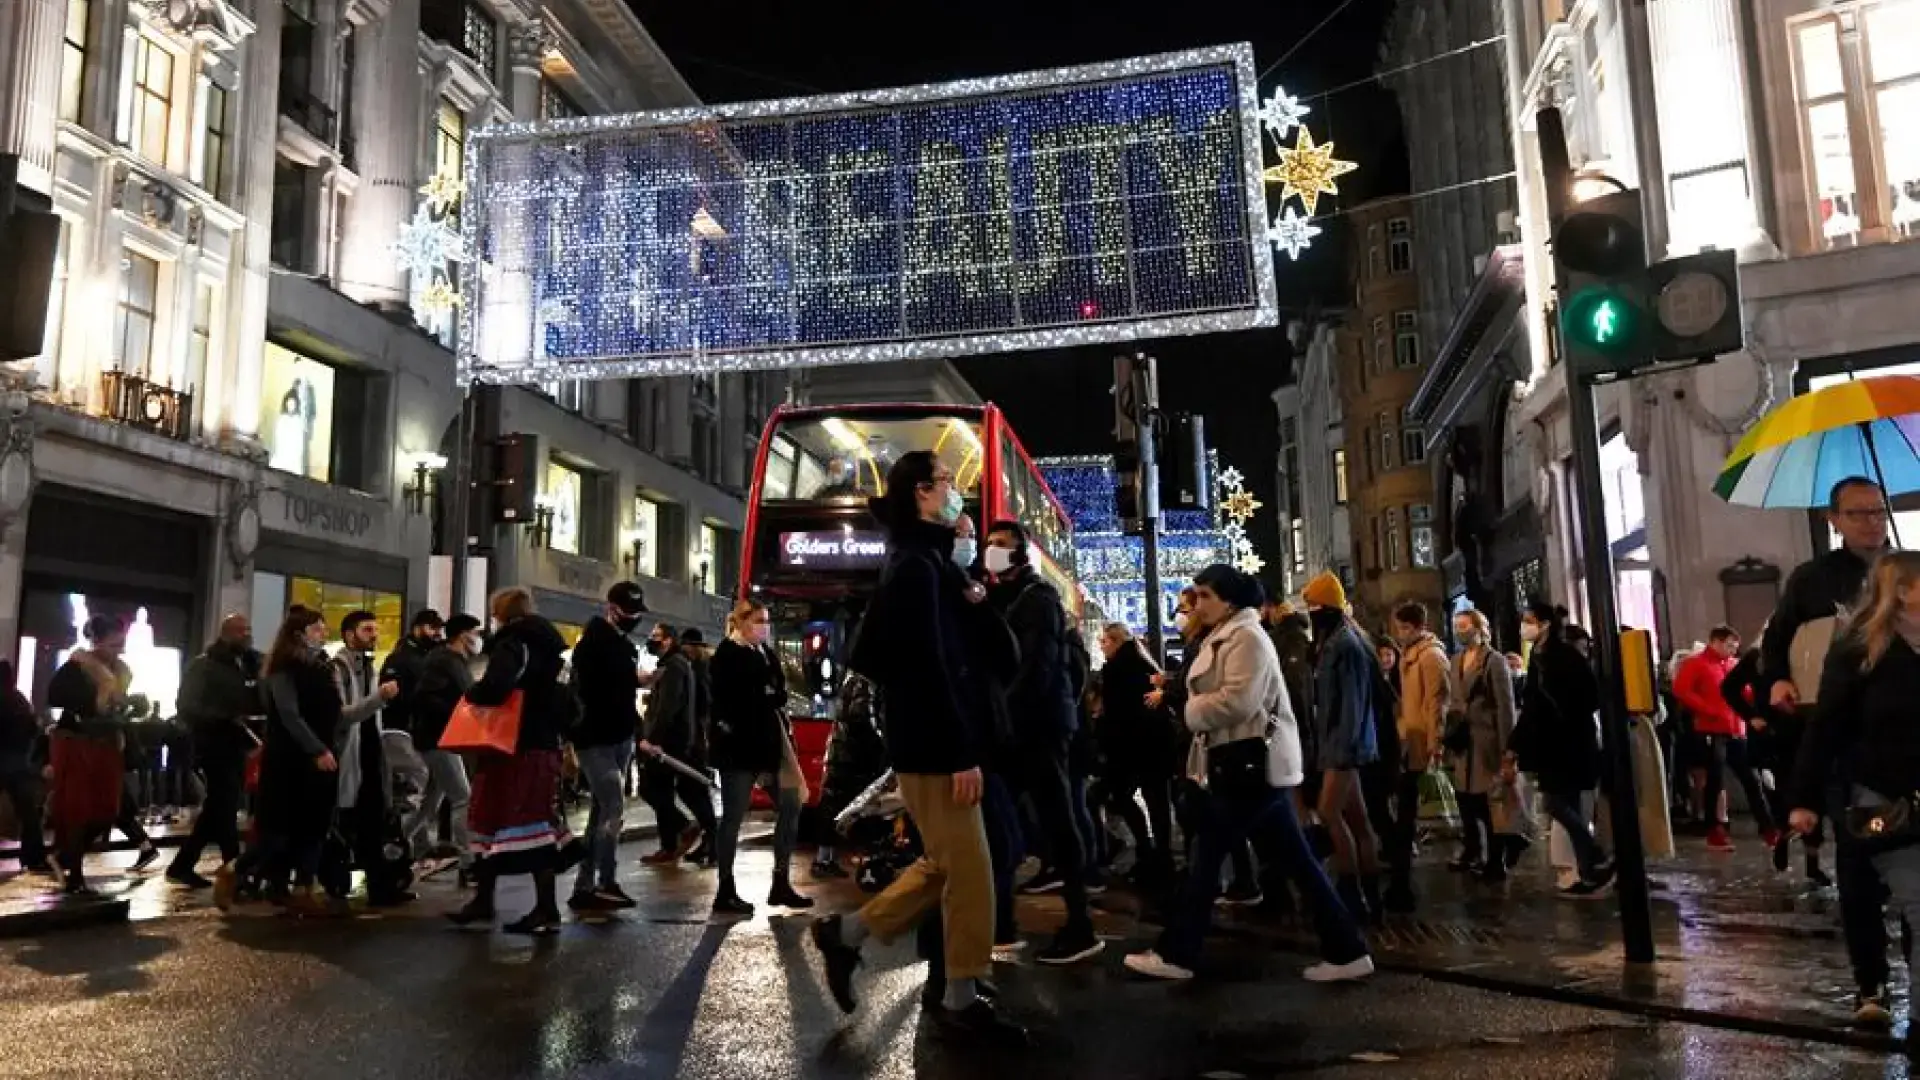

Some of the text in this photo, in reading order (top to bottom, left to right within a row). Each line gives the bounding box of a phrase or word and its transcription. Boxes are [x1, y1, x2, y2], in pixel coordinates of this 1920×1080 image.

[743, 107, 1236, 312] BEAUTY
[283, 494, 371, 537] TOPSHOP
[785, 537, 886, 555] Golders Green
